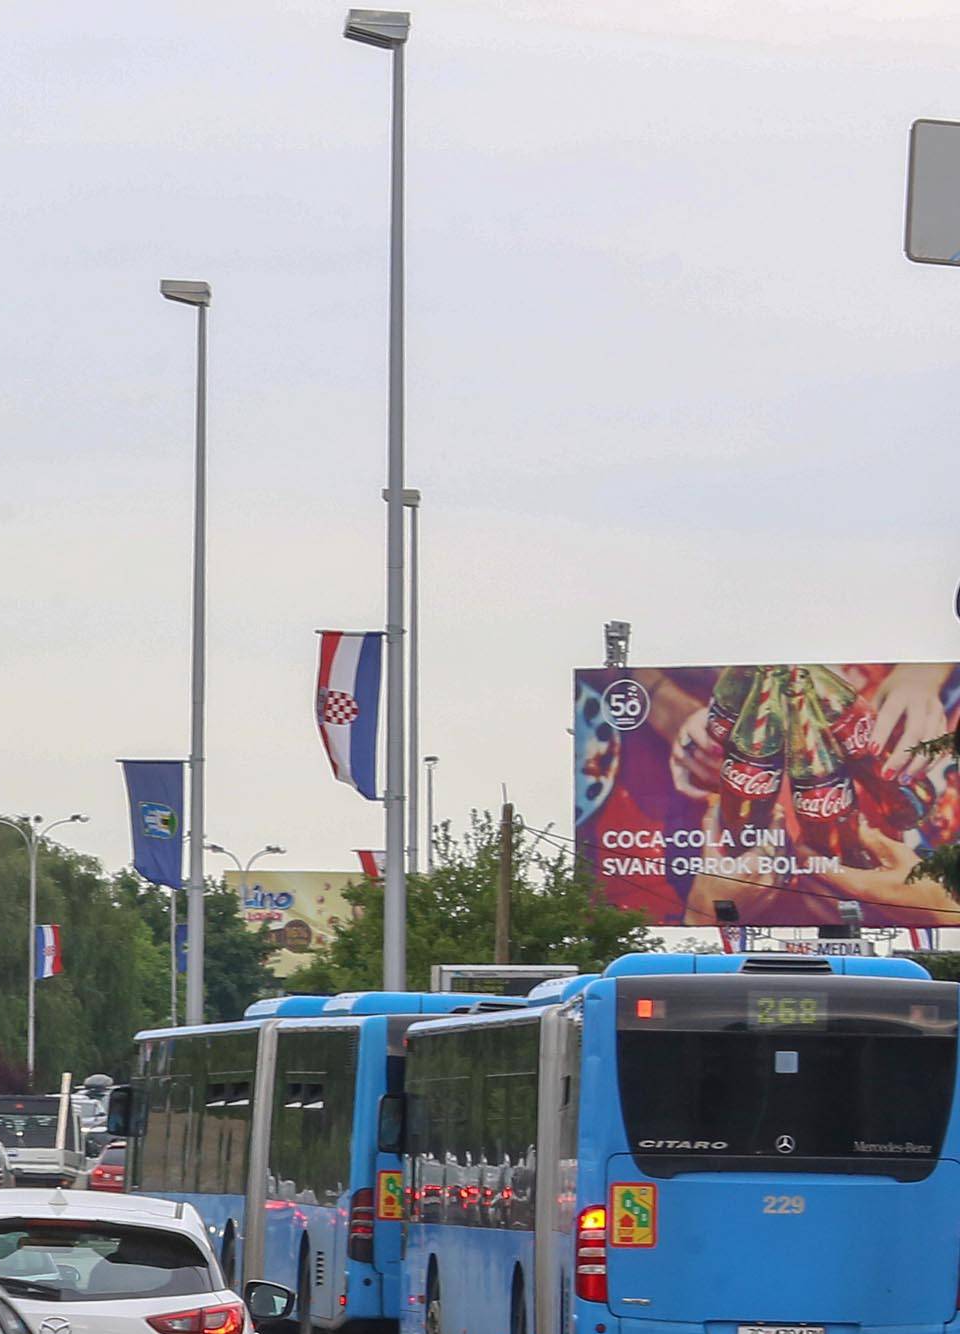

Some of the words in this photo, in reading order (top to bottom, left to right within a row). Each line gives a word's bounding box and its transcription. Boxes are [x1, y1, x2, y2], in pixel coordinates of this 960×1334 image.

[602, 829, 735, 849] COCA-COLA
[740, 824, 785, 847] ČINI
[602, 857, 666, 876] SVAKI
[672, 857, 756, 876] OBROK
[758, 856, 845, 875] BOLJIM.
[758, 998, 817, 1024] 268
[638, 1140, 729, 1150] CITARO
[763, 1197, 805, 1214] 229
